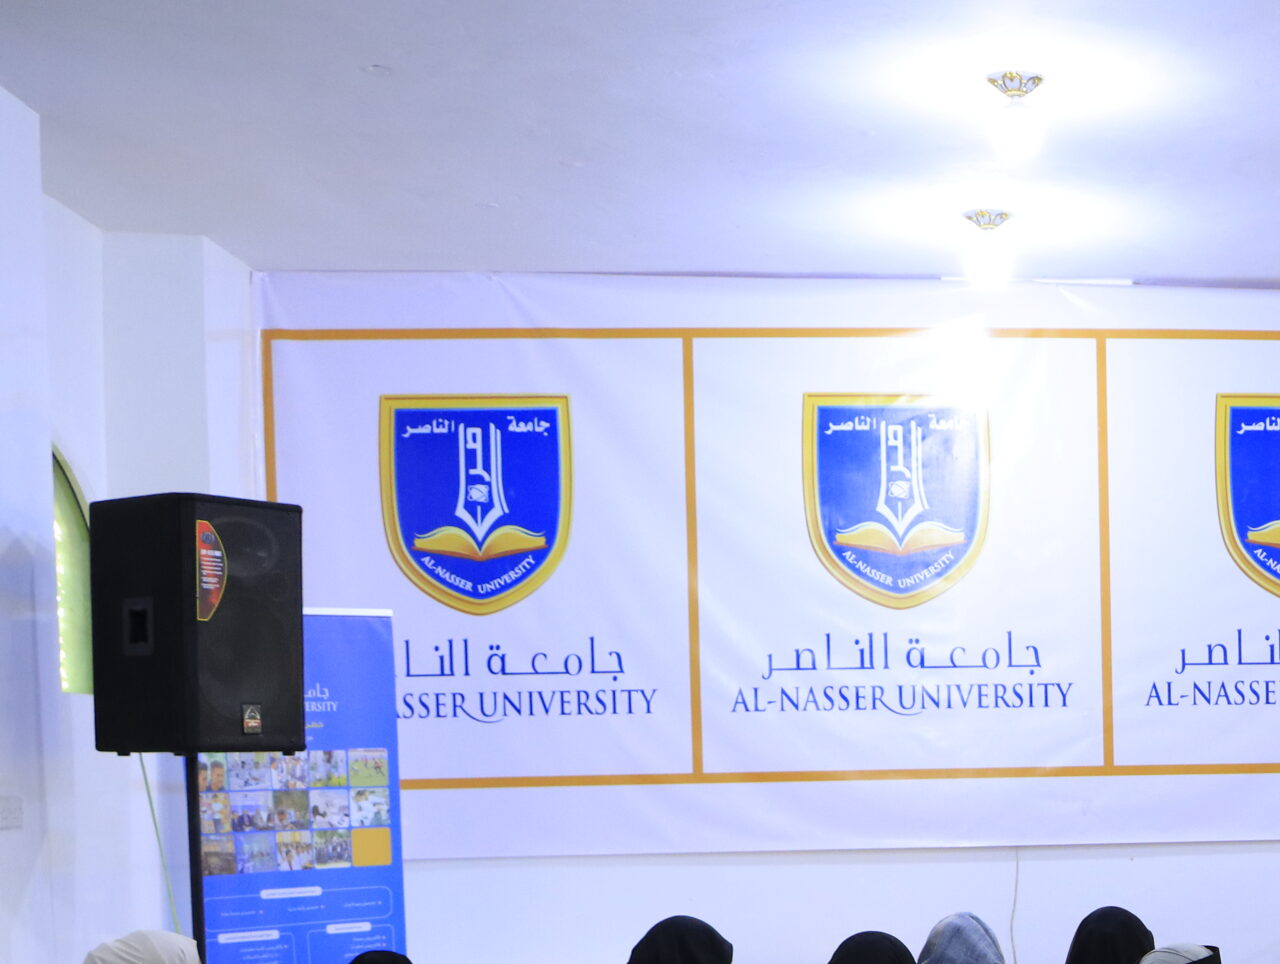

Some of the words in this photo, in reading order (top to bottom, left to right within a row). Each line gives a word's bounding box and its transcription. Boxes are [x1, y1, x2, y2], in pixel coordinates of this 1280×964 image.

[402, 418, 455, 439] الناصر
[507, 415, 551, 437] جامعة
[824, 415, 877, 435] الناصر
[420, 555, 474, 592] AL-NASSER
[477, 553, 537, 594] UNIVERSITY
[842, 550, 894, 587] AL-NASSER
[897, 550, 956, 589] UNIVERSITY
[396, 637, 471, 678] النا
[486, 635, 626, 682] جامعة
[761, 631, 890, 681] الناصر
[906, 630, 1042, 676] جامعة
[304, 700, 339, 712] ERSITY
[478, 688, 658, 718] UNIVERSITY
[731, 684, 921, 715] AL-NASSER
[896, 682, 1074, 710] UNIVERSITY
